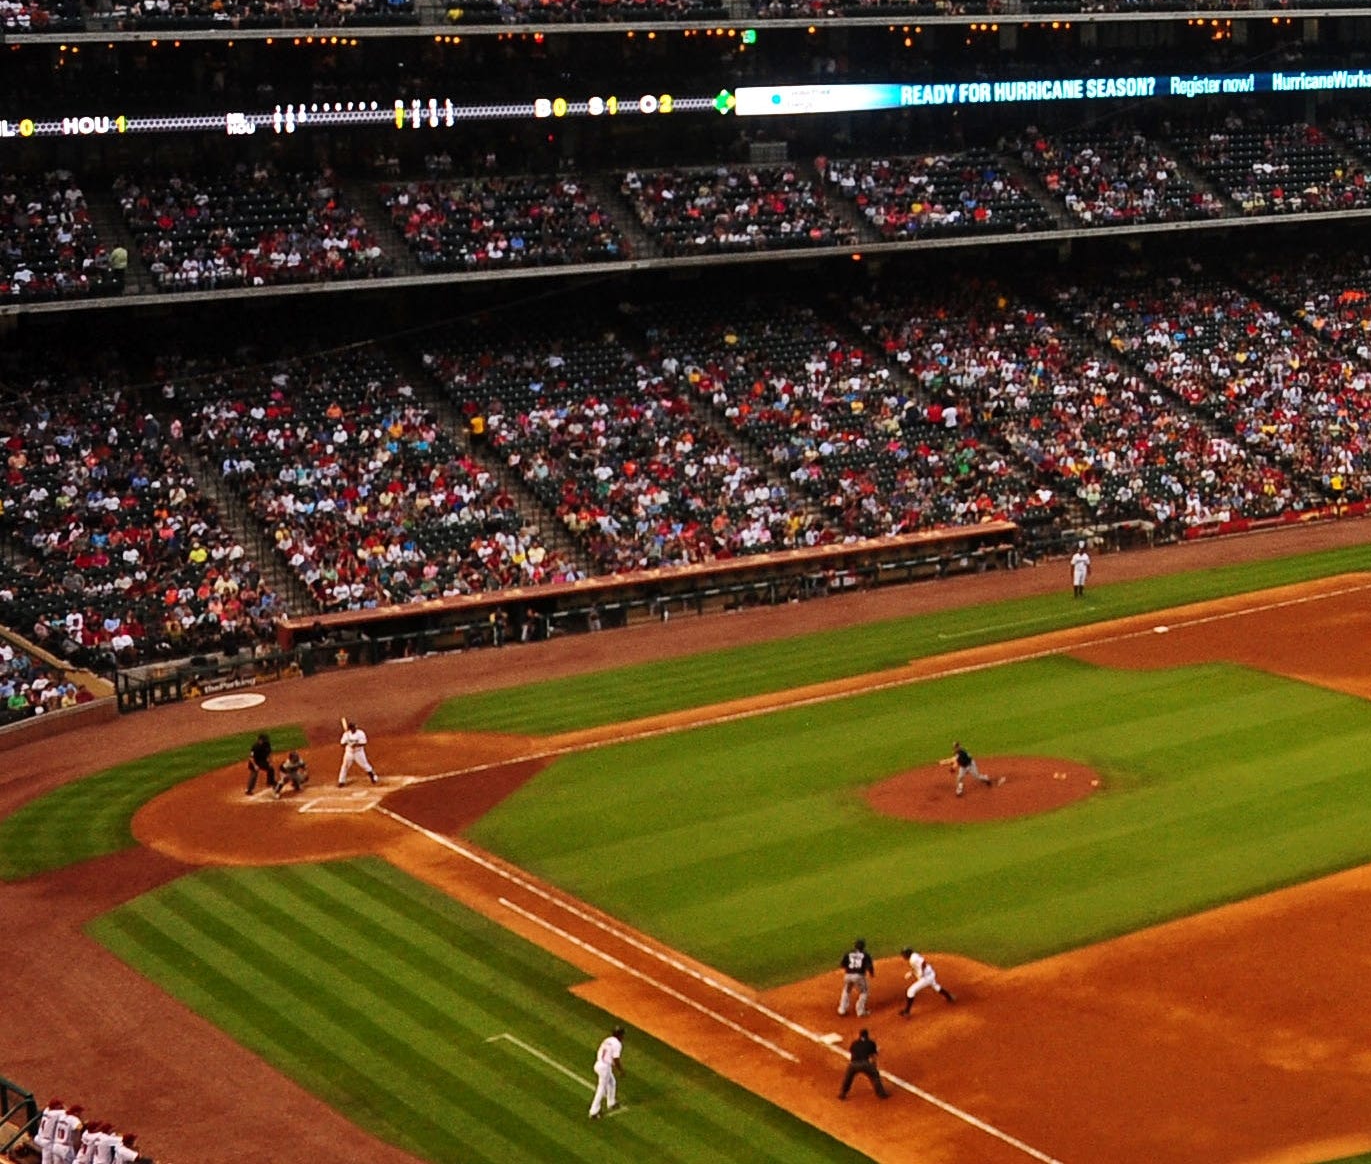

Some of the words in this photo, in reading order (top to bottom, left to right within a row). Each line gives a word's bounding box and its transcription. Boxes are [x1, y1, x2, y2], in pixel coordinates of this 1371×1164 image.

[901, 84, 956, 105] READY
[959, 83, 991, 103] FOR
[994, 79, 1083, 101] HURRICANE
[1086, 76, 1156, 98] SEASON?
[1171, 76, 1221, 98] Register
[1223, 74, 1254, 92] now!
[535, 98, 550, 118] B
[553, 98, 567, 117] 0
[607, 96, 617, 115] 1
[659, 94, 673, 113] 2
[19, 119, 34, 136] 0
[62, 116, 109, 135] HOU
[115, 115, 127, 133] 1
